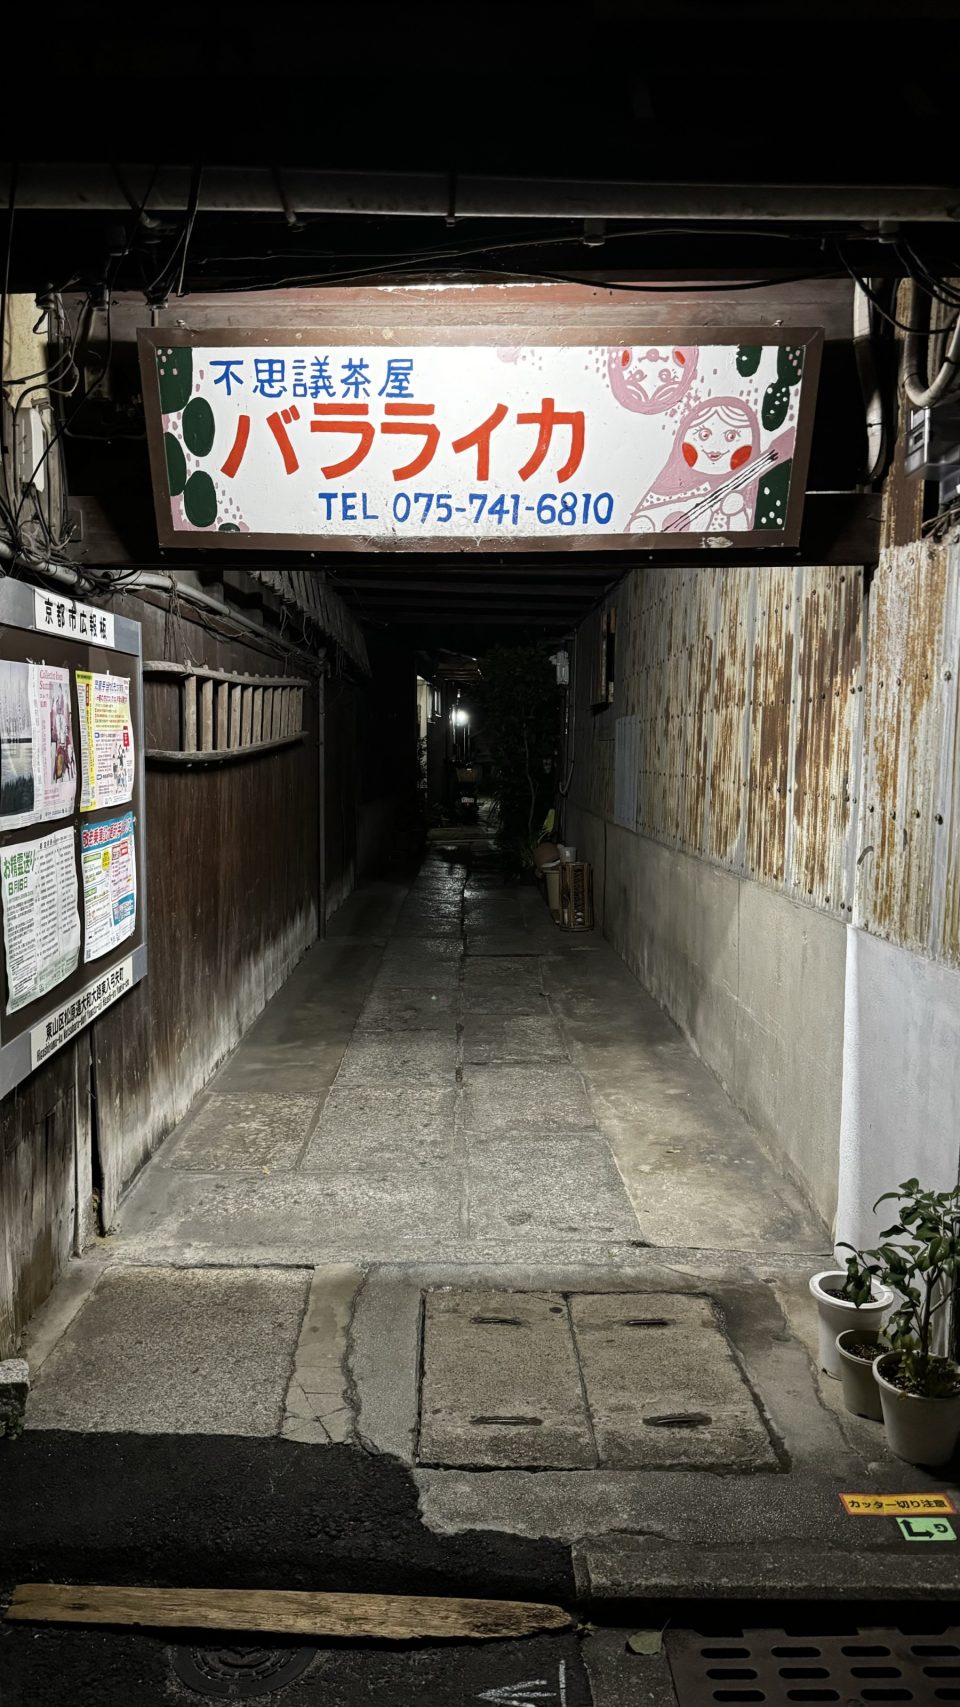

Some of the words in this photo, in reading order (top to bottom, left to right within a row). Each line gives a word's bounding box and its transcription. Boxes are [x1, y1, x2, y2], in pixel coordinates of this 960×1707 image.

[210, 354, 415, 400] 不思議茶屋
[220, 397, 586, 484] バラライカ
[318, 491, 379, 521] TEL
[392, 491, 615, 526] 075-741-6810
[44, 597, 108, 641] 京都市広報板
[848, 1499, 947, 1509] カッター切り注意
